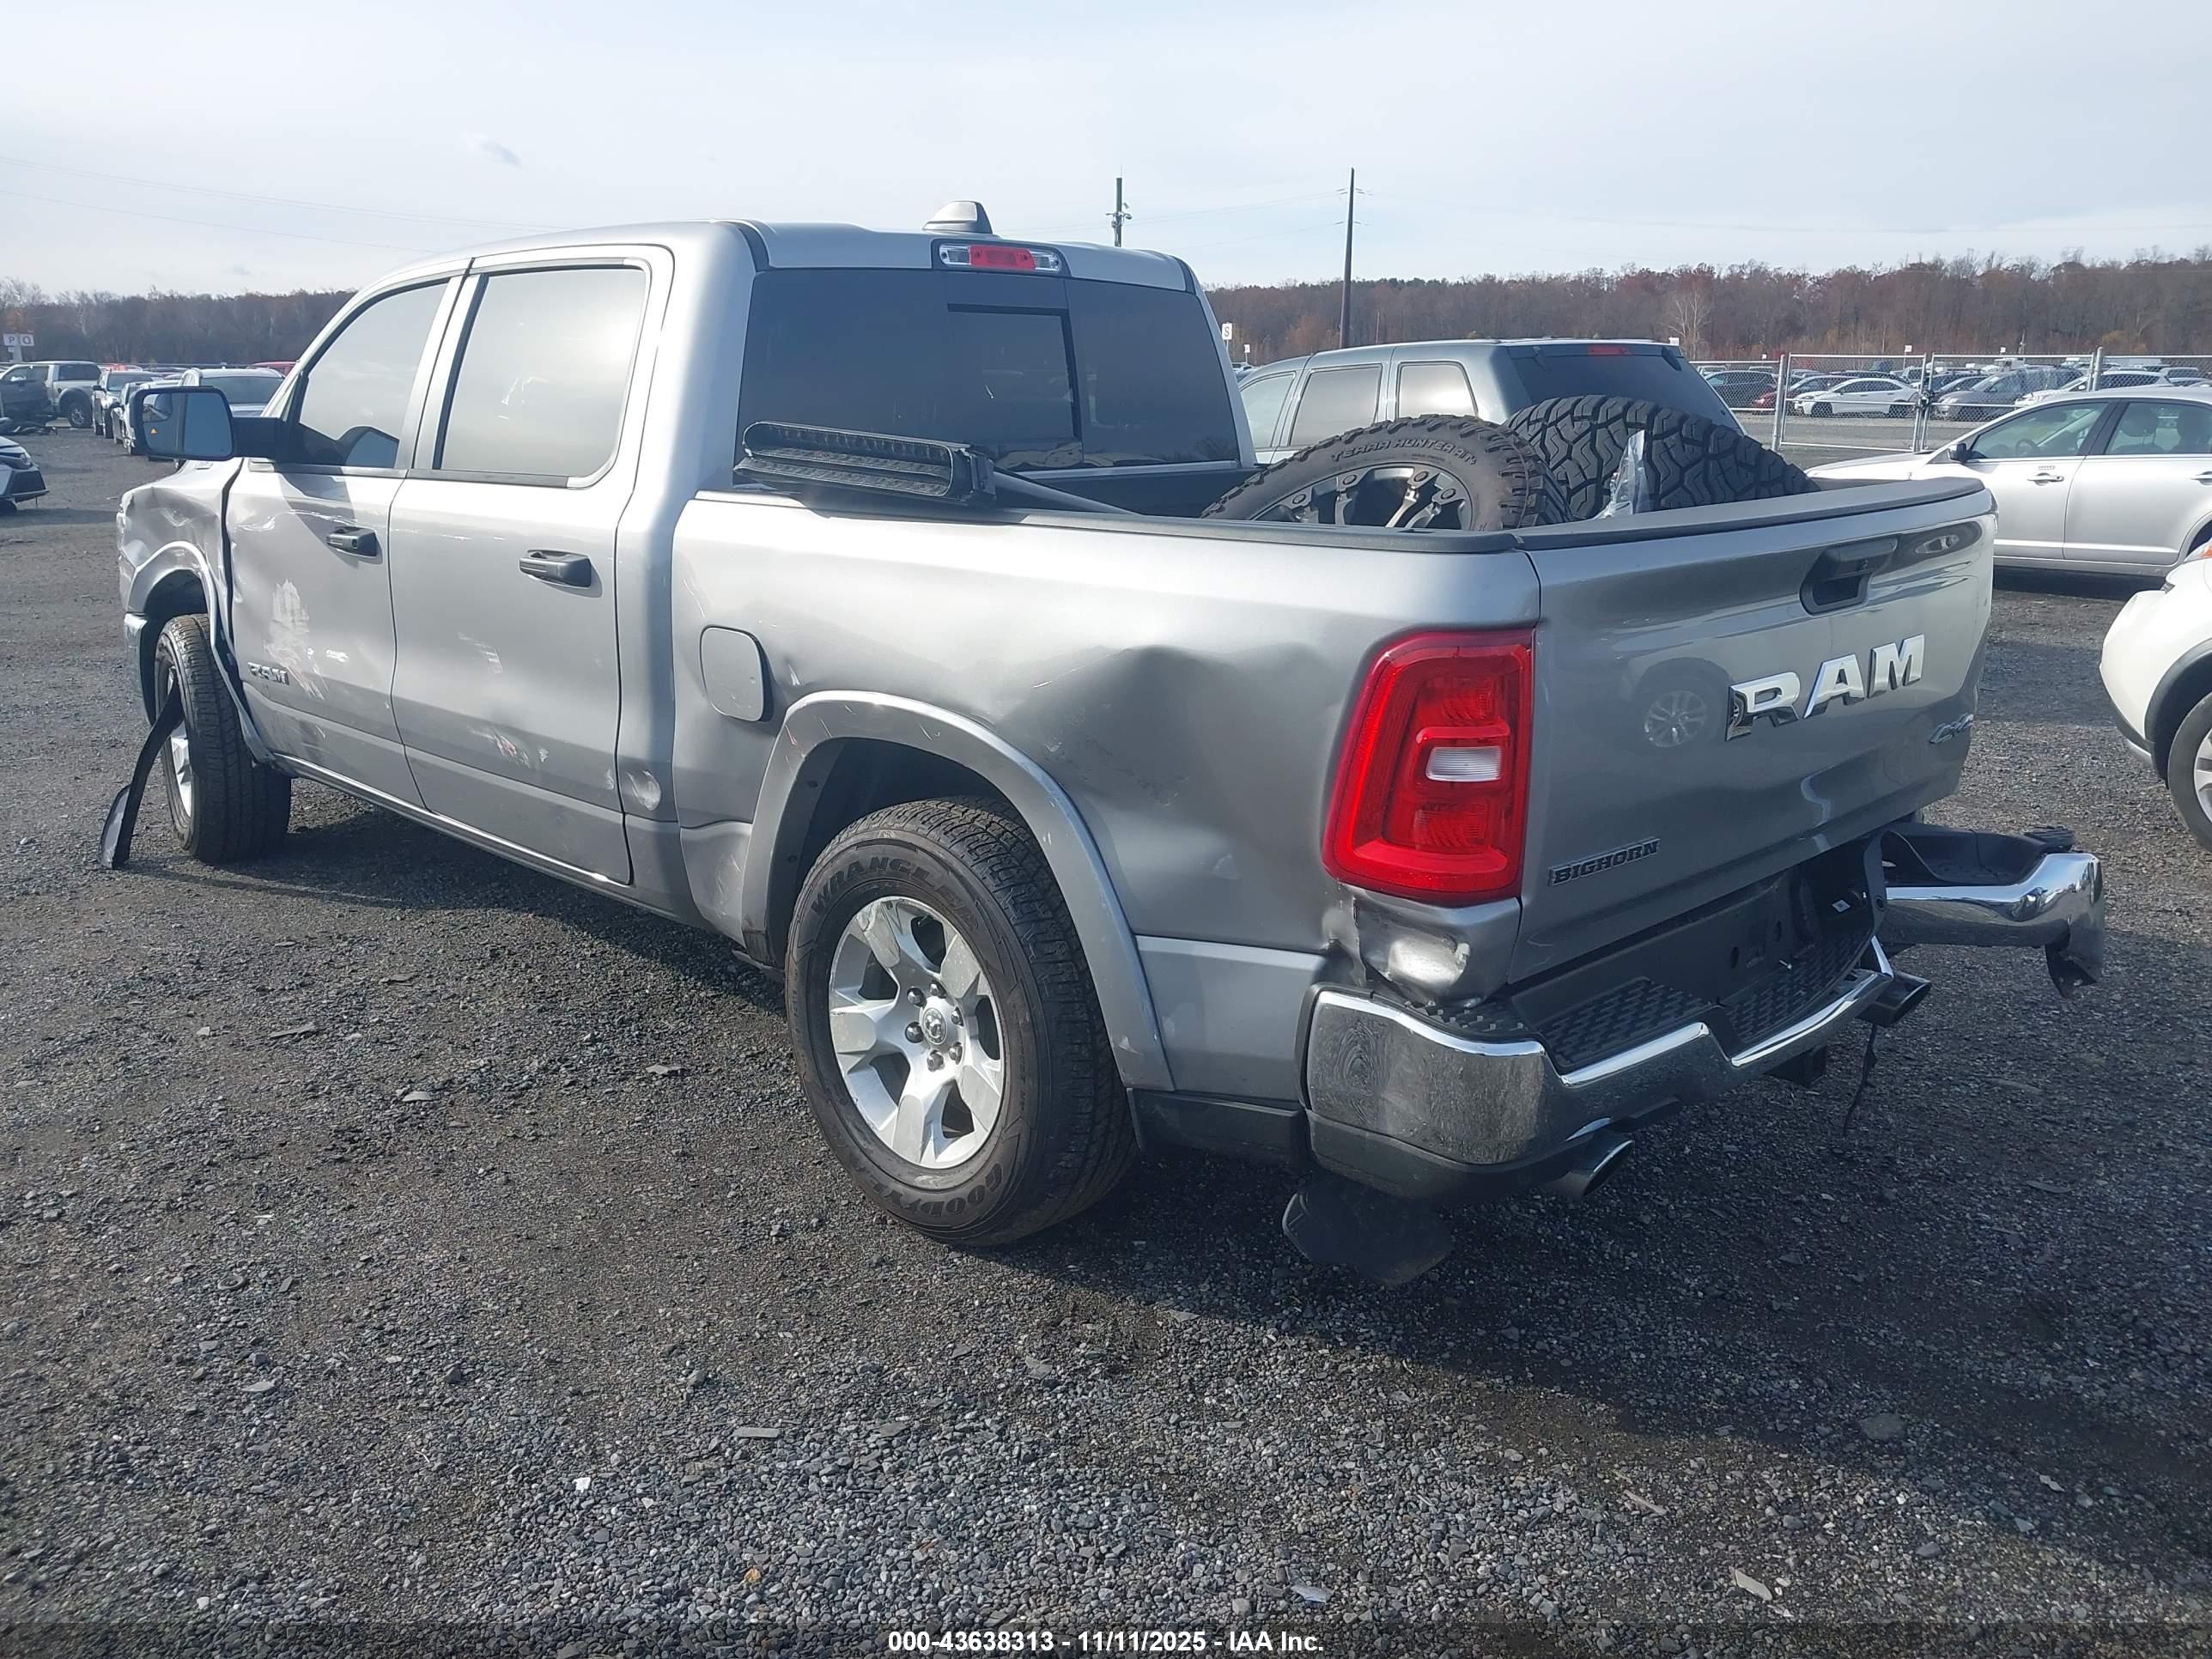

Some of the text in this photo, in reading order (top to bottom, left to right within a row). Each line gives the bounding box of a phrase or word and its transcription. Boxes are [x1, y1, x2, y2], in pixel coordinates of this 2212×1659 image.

[1224, 325, 1230, 337] S
[1331, 441, 1391, 462] TERRA
[1393, 439, 1454, 453] HUNTER
[247, 661, 290, 686] RAM
[1725, 634, 1924, 741] RAM
[1549, 837, 1660, 885] BIGHORN
[811, 856, 979, 931] WRANGLER
